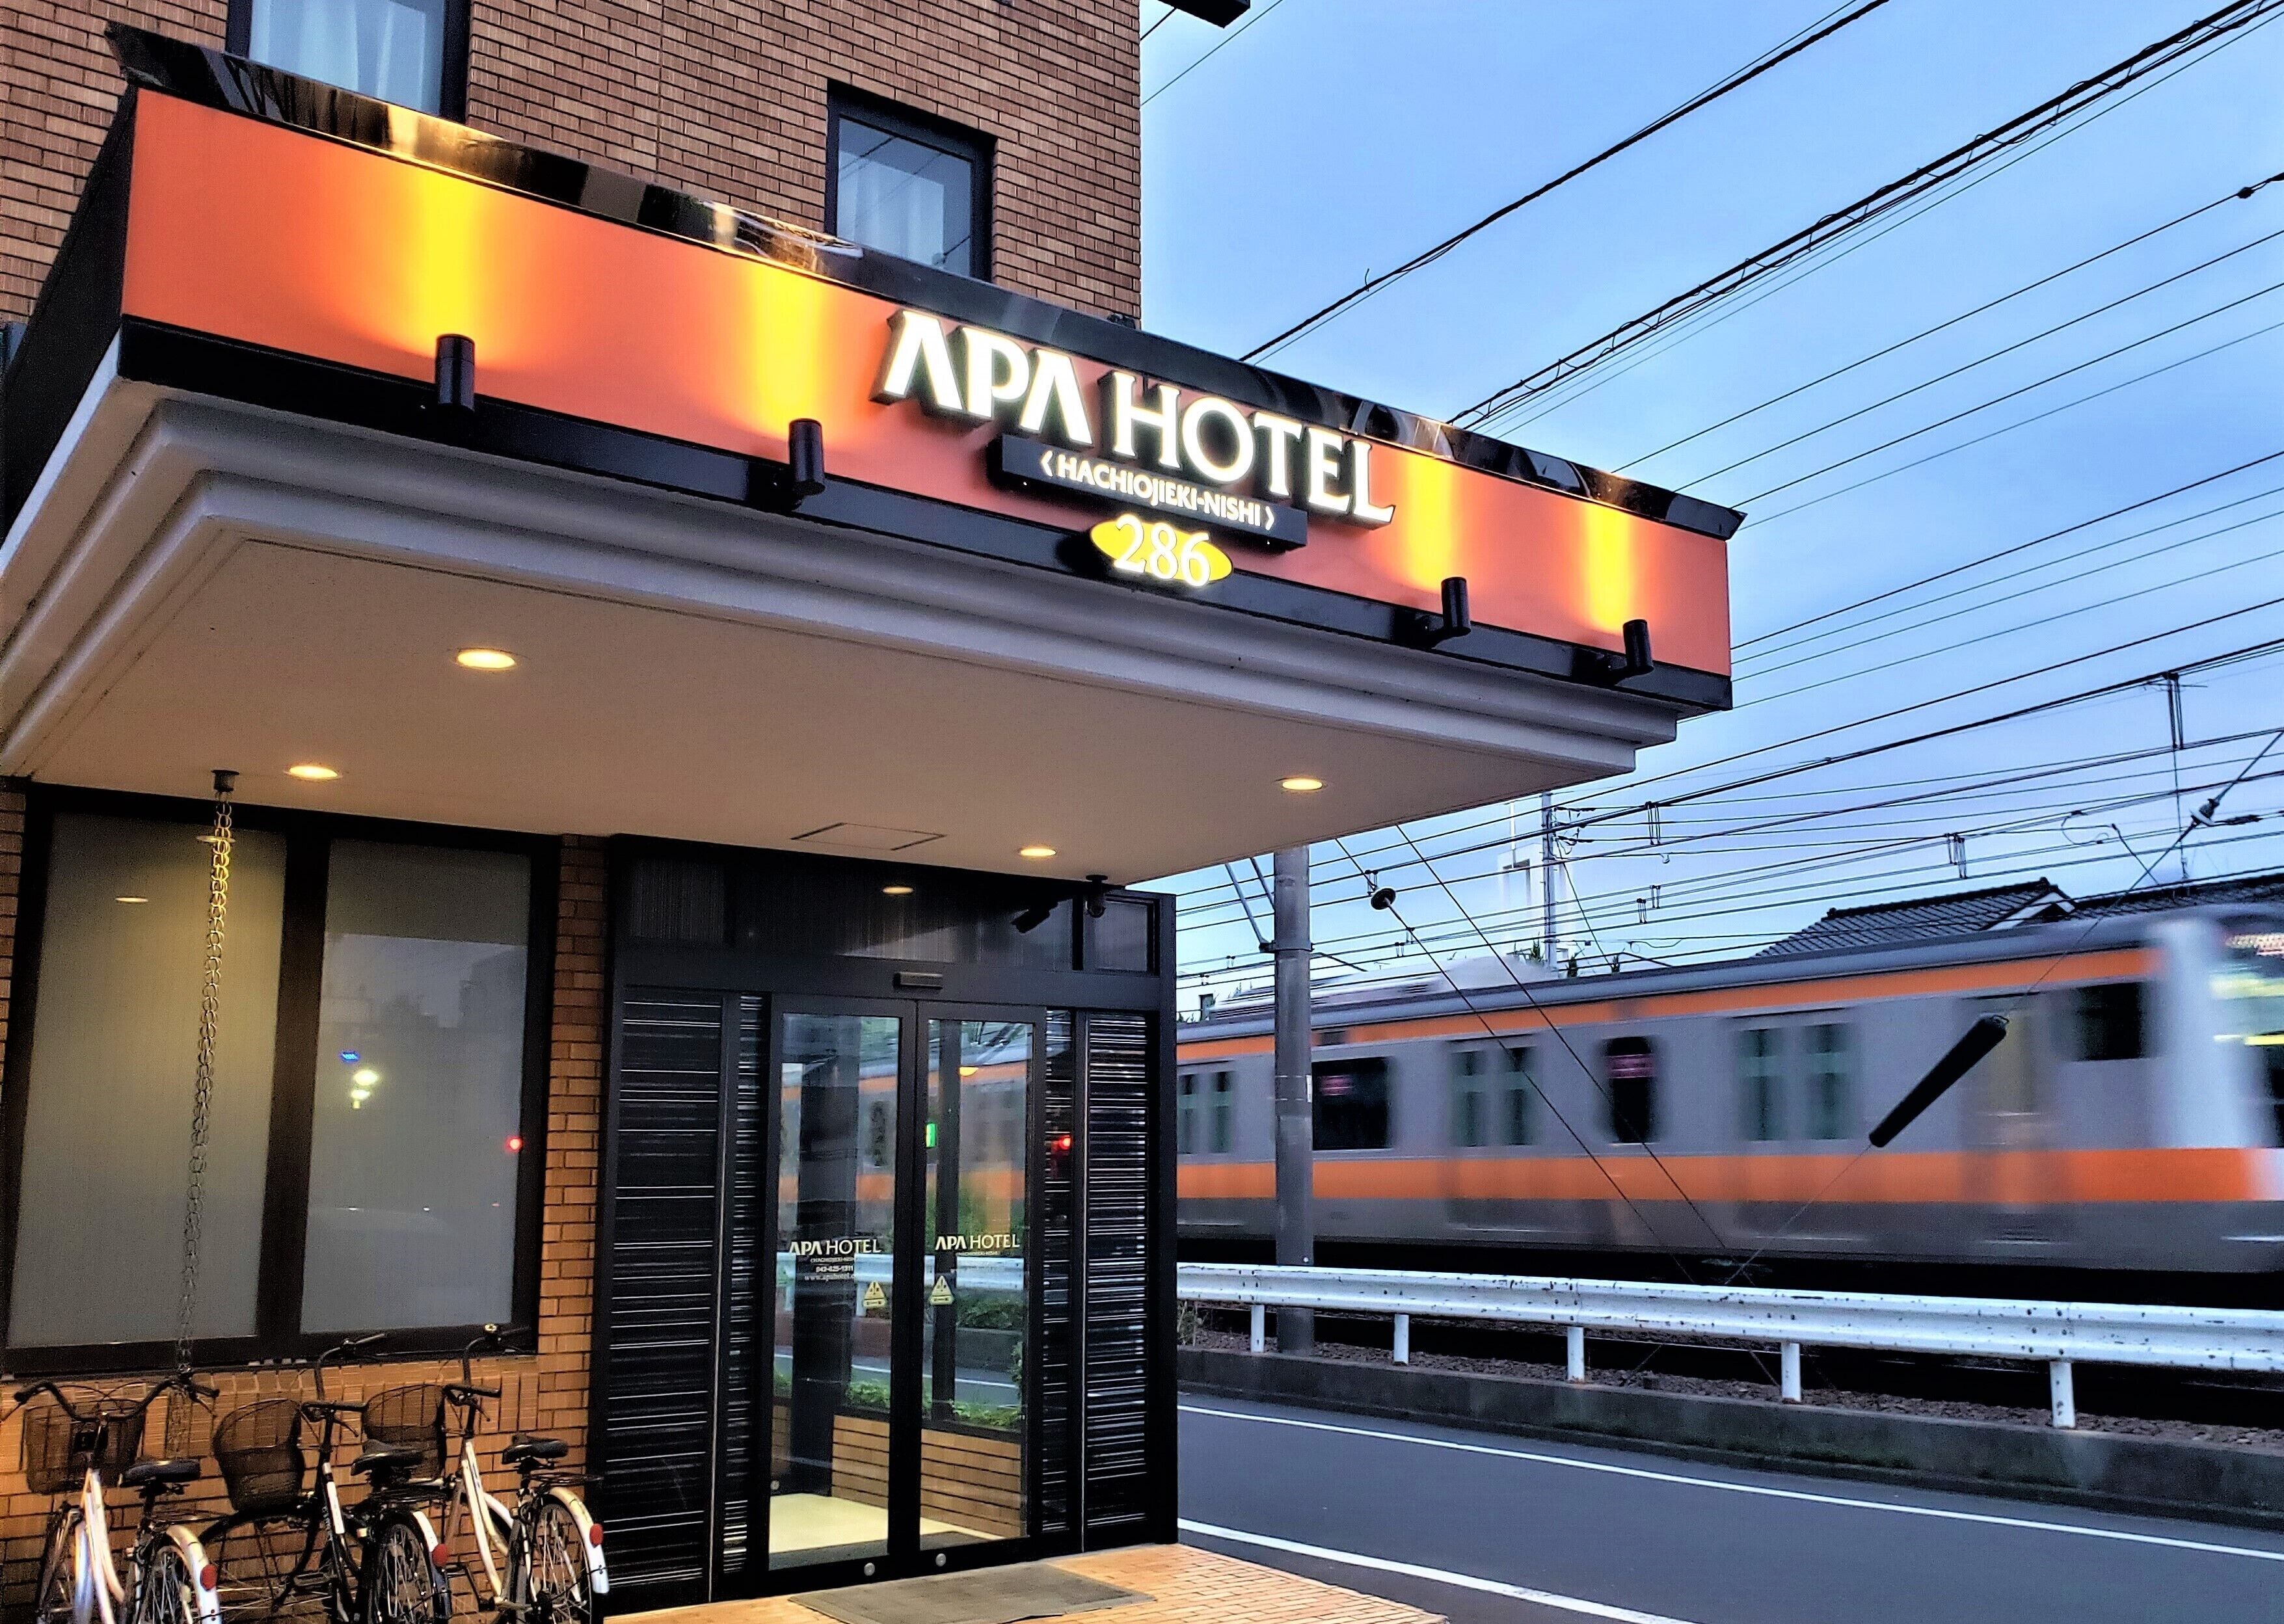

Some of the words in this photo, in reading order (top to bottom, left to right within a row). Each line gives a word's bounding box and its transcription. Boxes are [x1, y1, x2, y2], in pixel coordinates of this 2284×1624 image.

[881, 309, 1095, 447] APA
[1112, 370, 1396, 523] HOTEL
[1113, 513, 1211, 587] 286
[789, 1240, 823, 1256] APA
[826, 1239, 882, 1255] HOTEL
[935, 1236, 967, 1250] APA
[970, 1234, 1020, 1249] HOTEL
